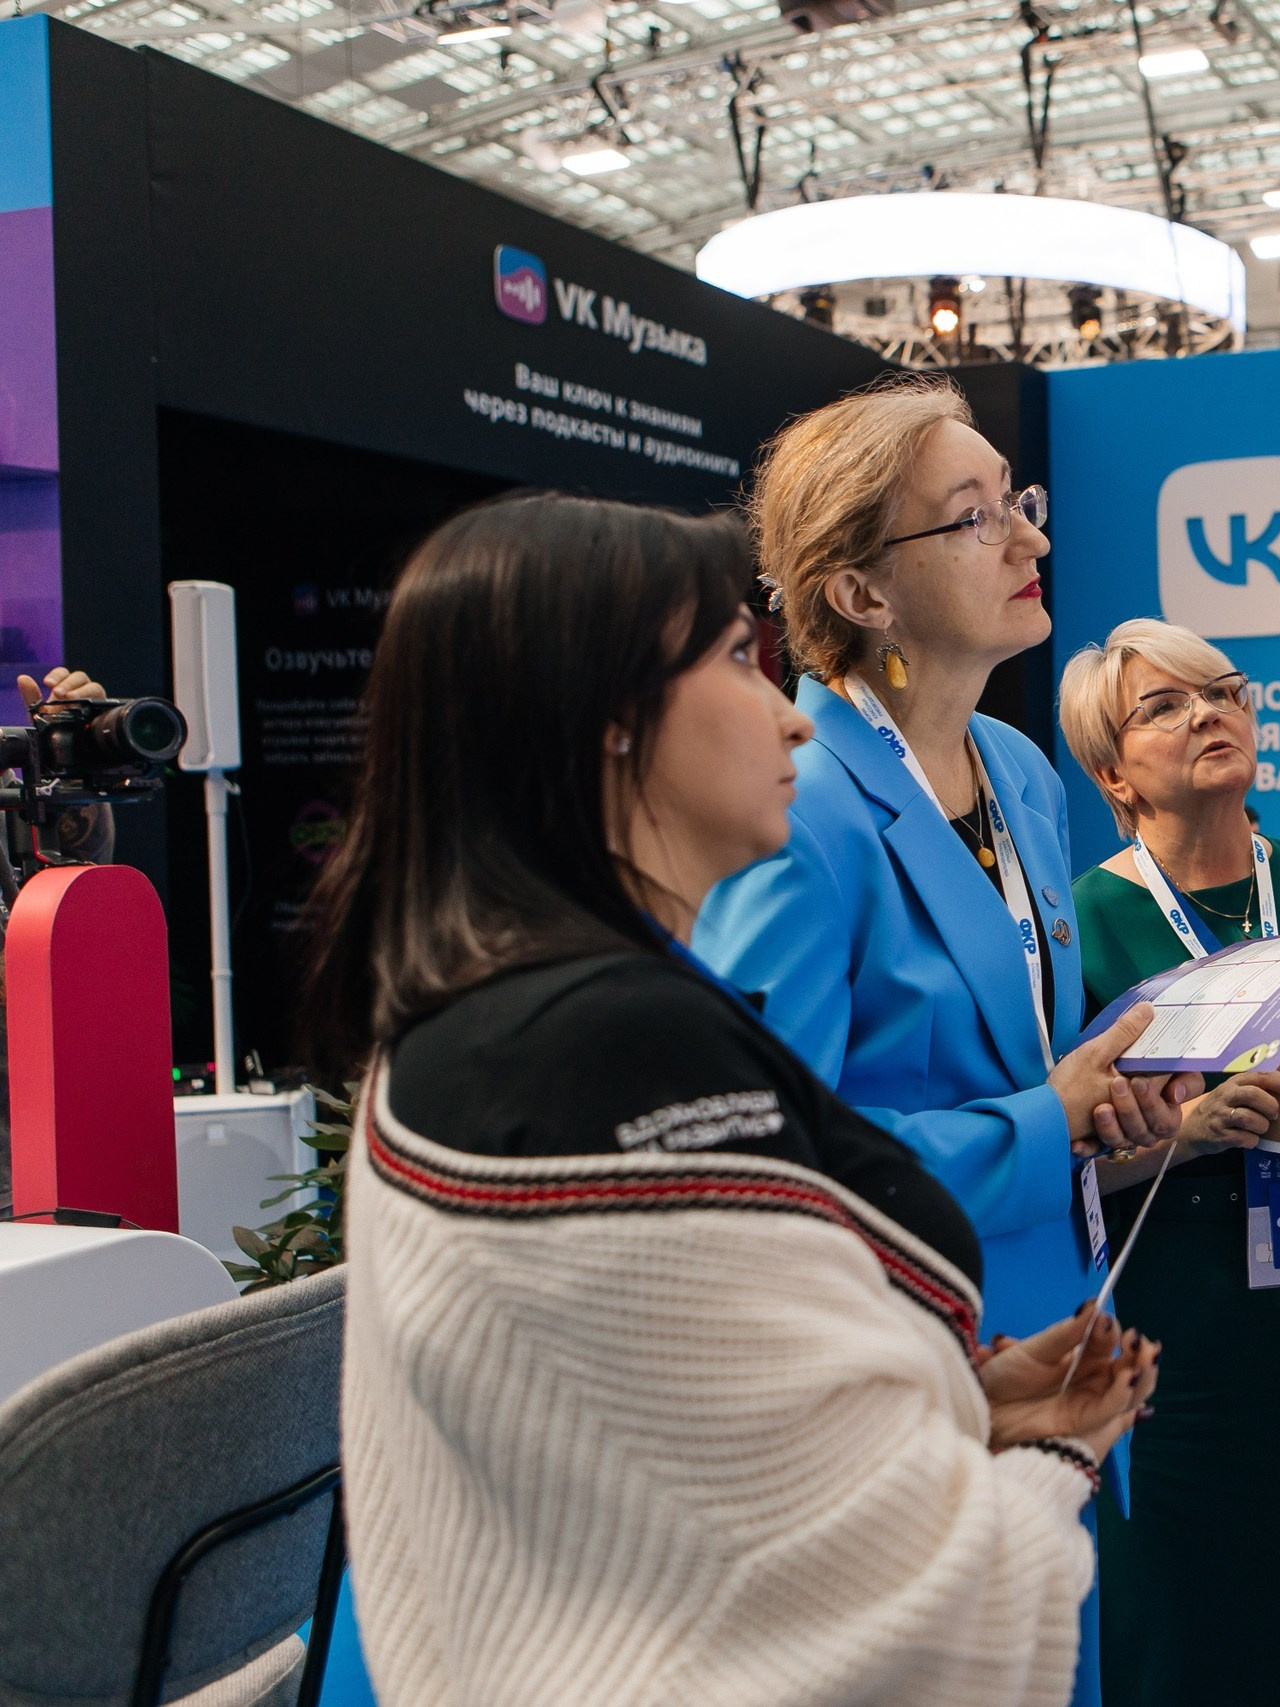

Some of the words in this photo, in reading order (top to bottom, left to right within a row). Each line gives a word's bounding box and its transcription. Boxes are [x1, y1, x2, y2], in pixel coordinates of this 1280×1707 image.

[554, 277, 598, 330] VK
[602, 296, 707, 366] Музыка
[515, 362, 559, 399] Ваш
[562, 381, 612, 413] ключ
[615, 397, 627, 416] к
[630, 402, 702, 438] знаниям
[464, 388, 528, 424] через
[531, 407, 626, 440] подкасты
[628, 433, 641, 453] и
[644, 437, 740, 478] аудиокниги
[264, 646, 373, 676] Озвучьте
[877, 725, 906, 759] ФКР
[989, 799, 1004, 834] ФКР
[1254, 840, 1265, 863] ФКР
[1019, 918, 1036, 955] ФКР
[1170, 909, 1190, 935] ФКР
[1264, 920, 1275, 938] КР
